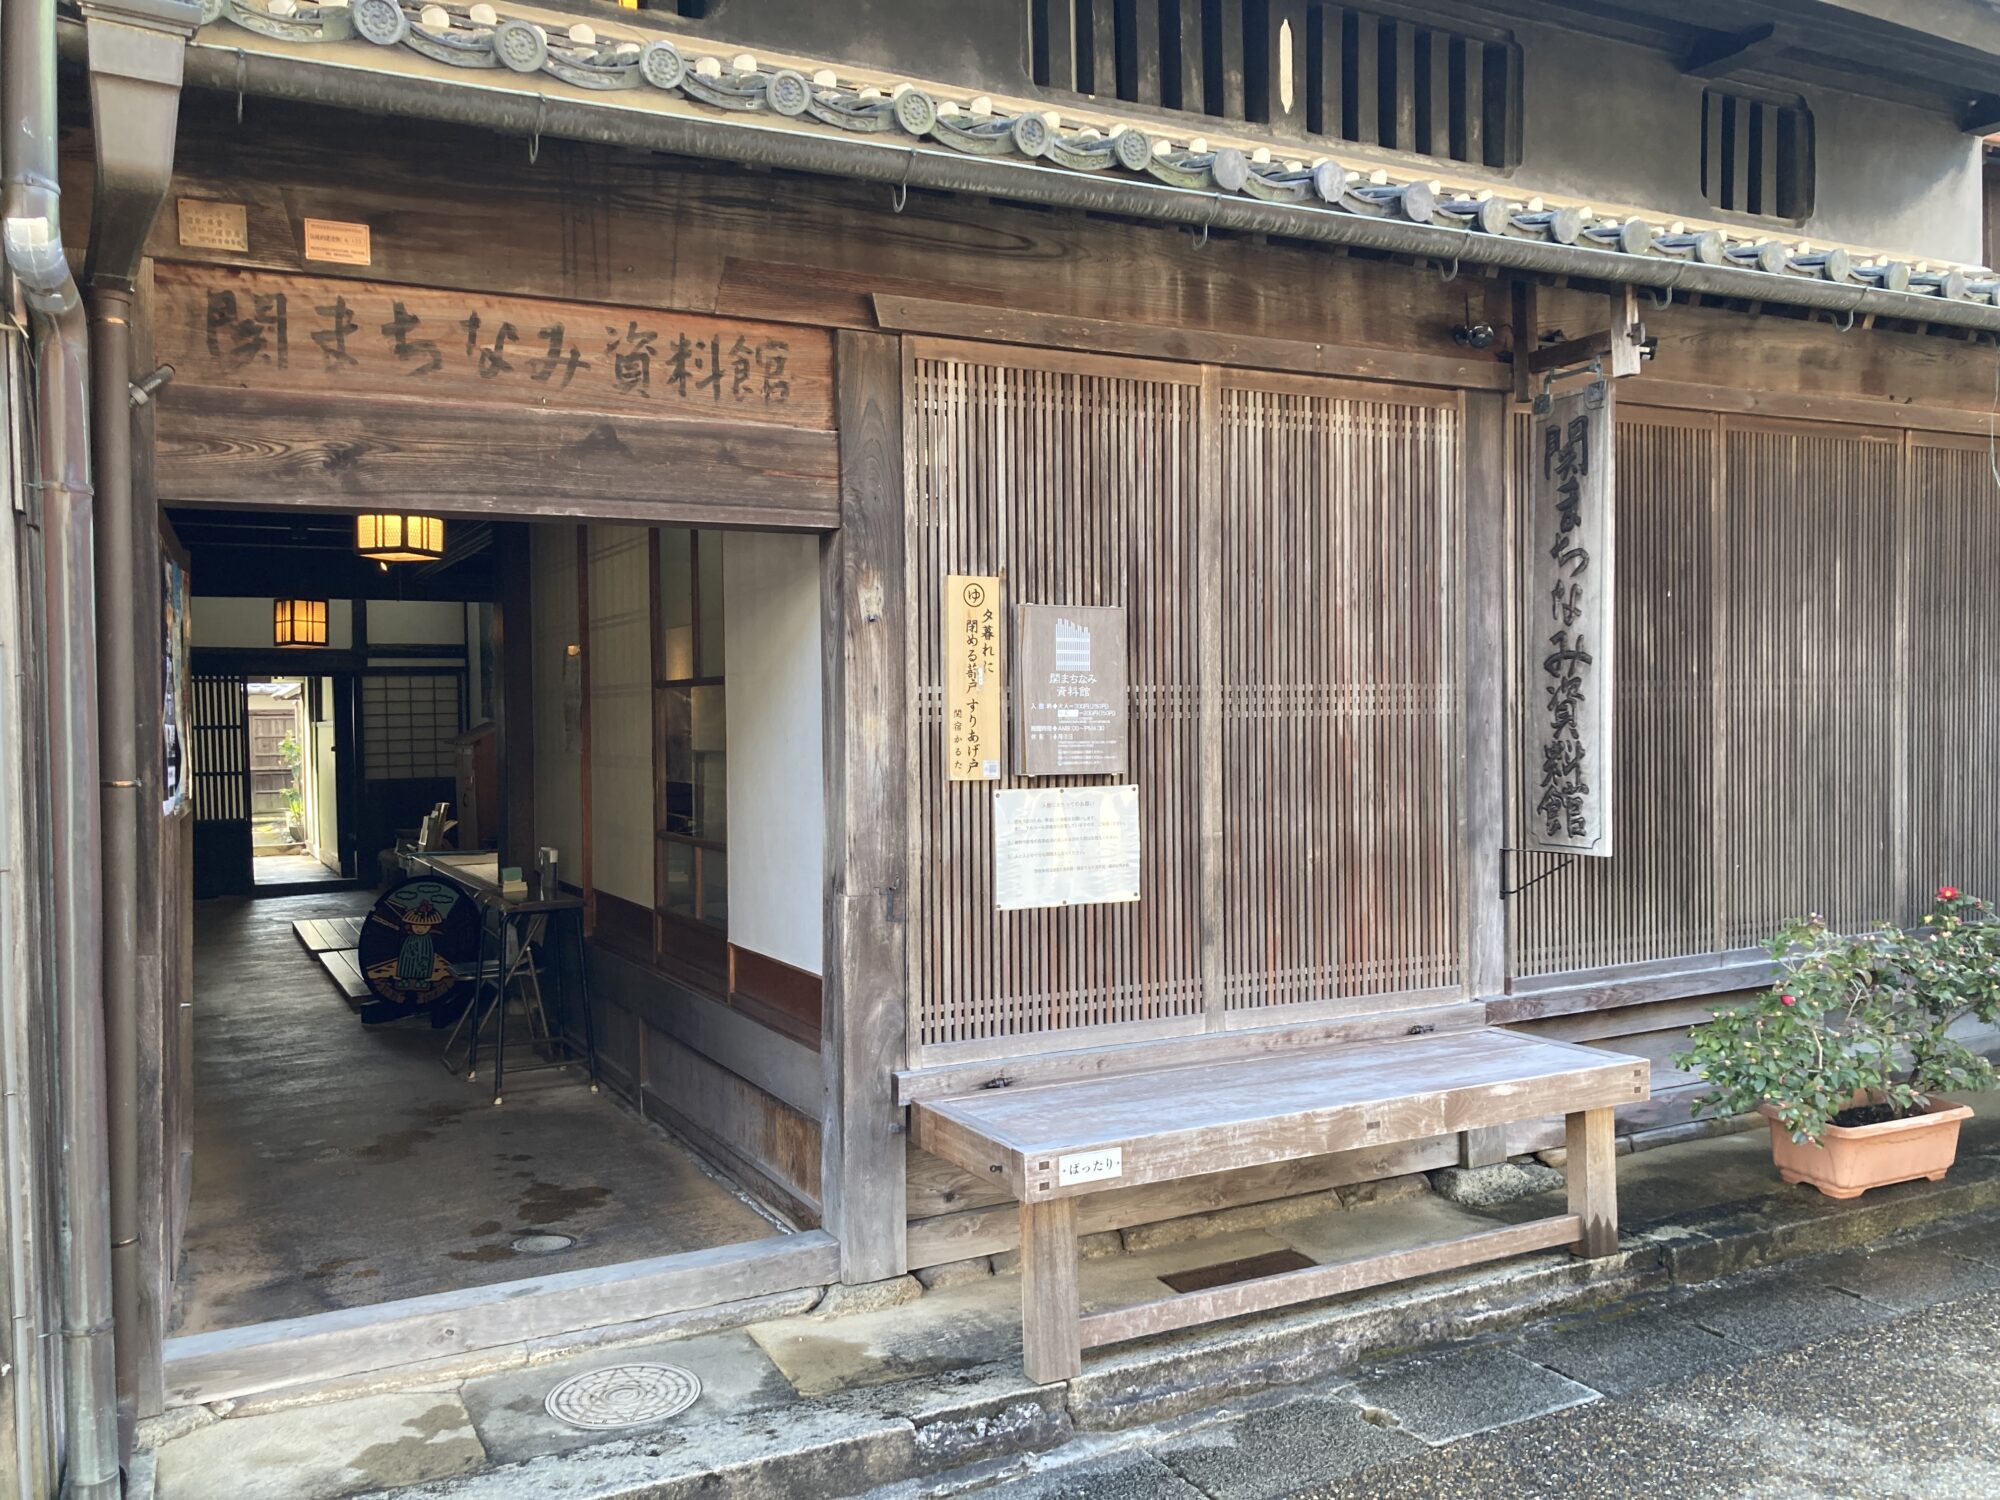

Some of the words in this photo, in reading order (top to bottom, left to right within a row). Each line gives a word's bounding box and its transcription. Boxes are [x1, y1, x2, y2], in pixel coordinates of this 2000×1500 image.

[206, 289, 790, 404] 関まちなみ資料館
[981, 608, 995, 674] 夕暮れに
[1536, 415, 1591, 838] 関まちなみ資料館
